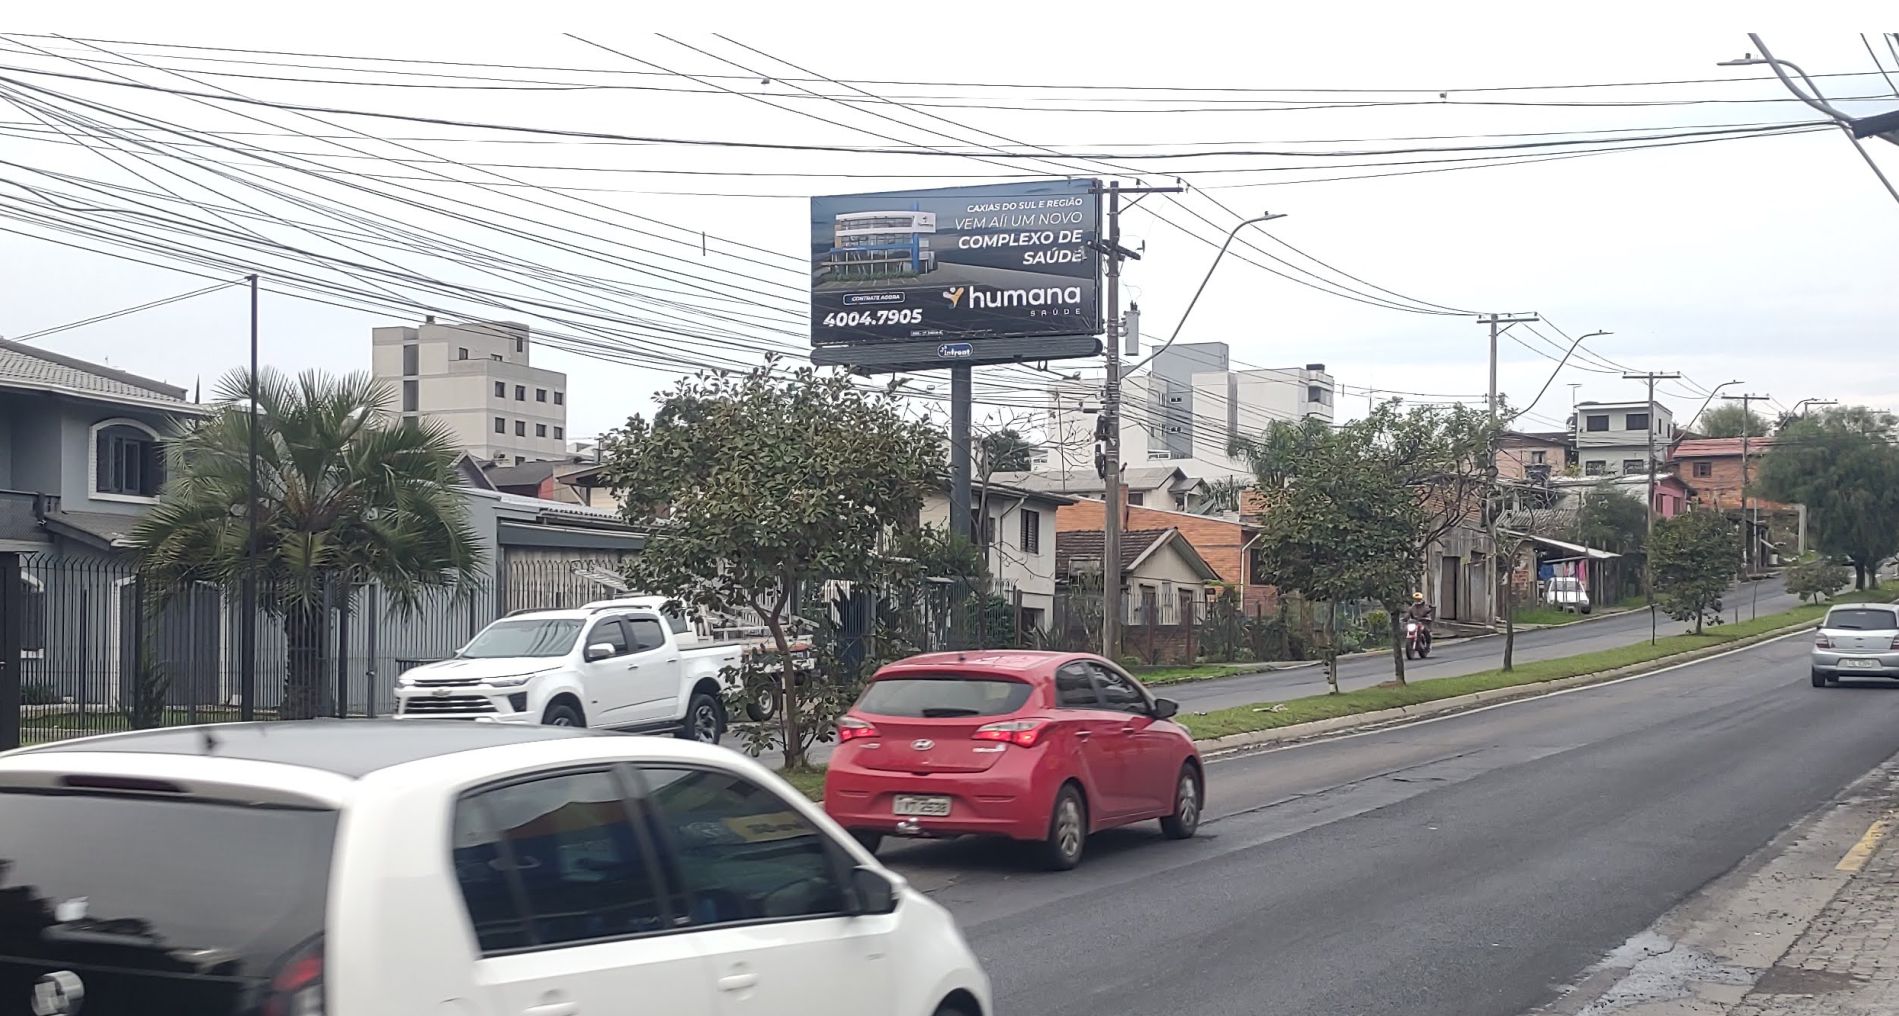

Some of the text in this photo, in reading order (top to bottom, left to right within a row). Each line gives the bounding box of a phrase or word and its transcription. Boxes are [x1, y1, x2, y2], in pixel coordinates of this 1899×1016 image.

[967, 197, 1083, 213] CAXIAS DO SUL E REGIÃO
[955, 217, 986, 230] VEM
[1011, 213, 1035, 227] UM
[1039, 211, 1083, 225] NOVO
[958, 229, 1083, 249] COMPLEXO DE
[1022, 247, 1083, 265] SAÚDE
[969, 286, 1081, 309] humana
[823, 308, 923, 327] 4004.7905
[1030, 308, 1081, 317] SAÚDE
